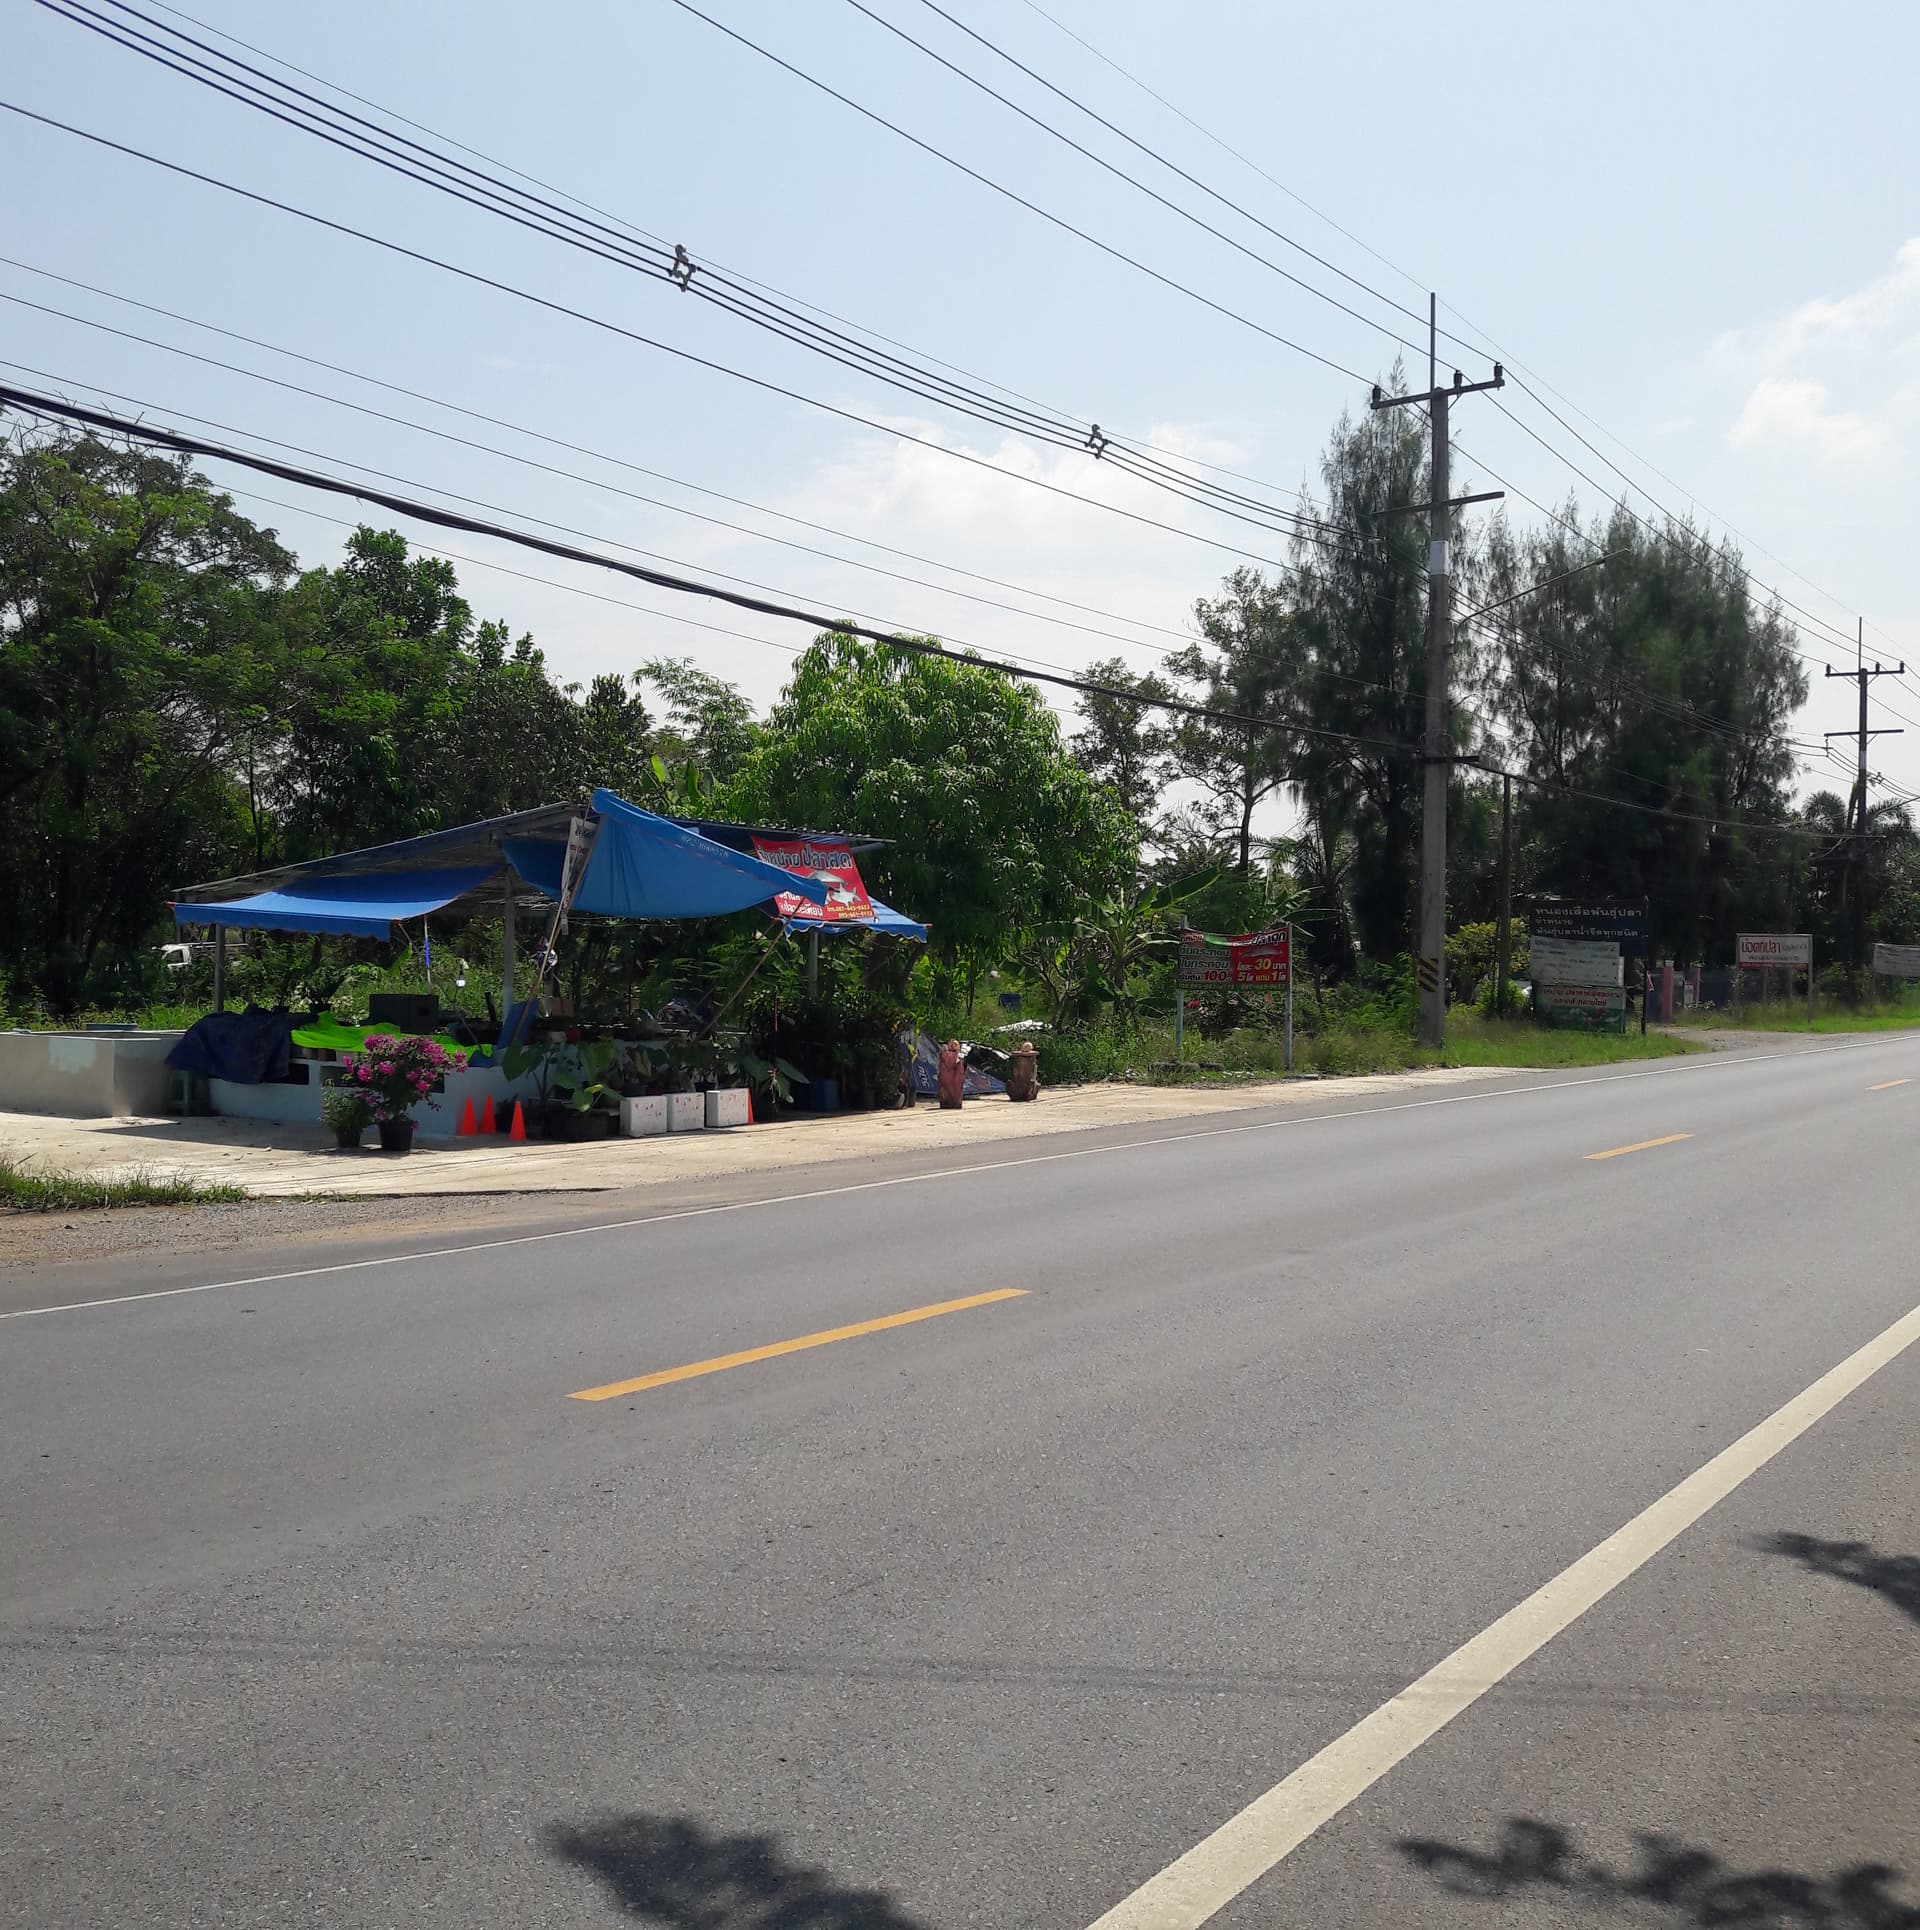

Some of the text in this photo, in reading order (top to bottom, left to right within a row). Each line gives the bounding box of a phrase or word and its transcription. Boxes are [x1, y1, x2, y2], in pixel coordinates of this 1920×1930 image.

[801, 843, 854, 870] ปลาสด
[1741, 938, 1781, 953] บ่อตกปลา
[1254, 958, 1272, 970] 30
